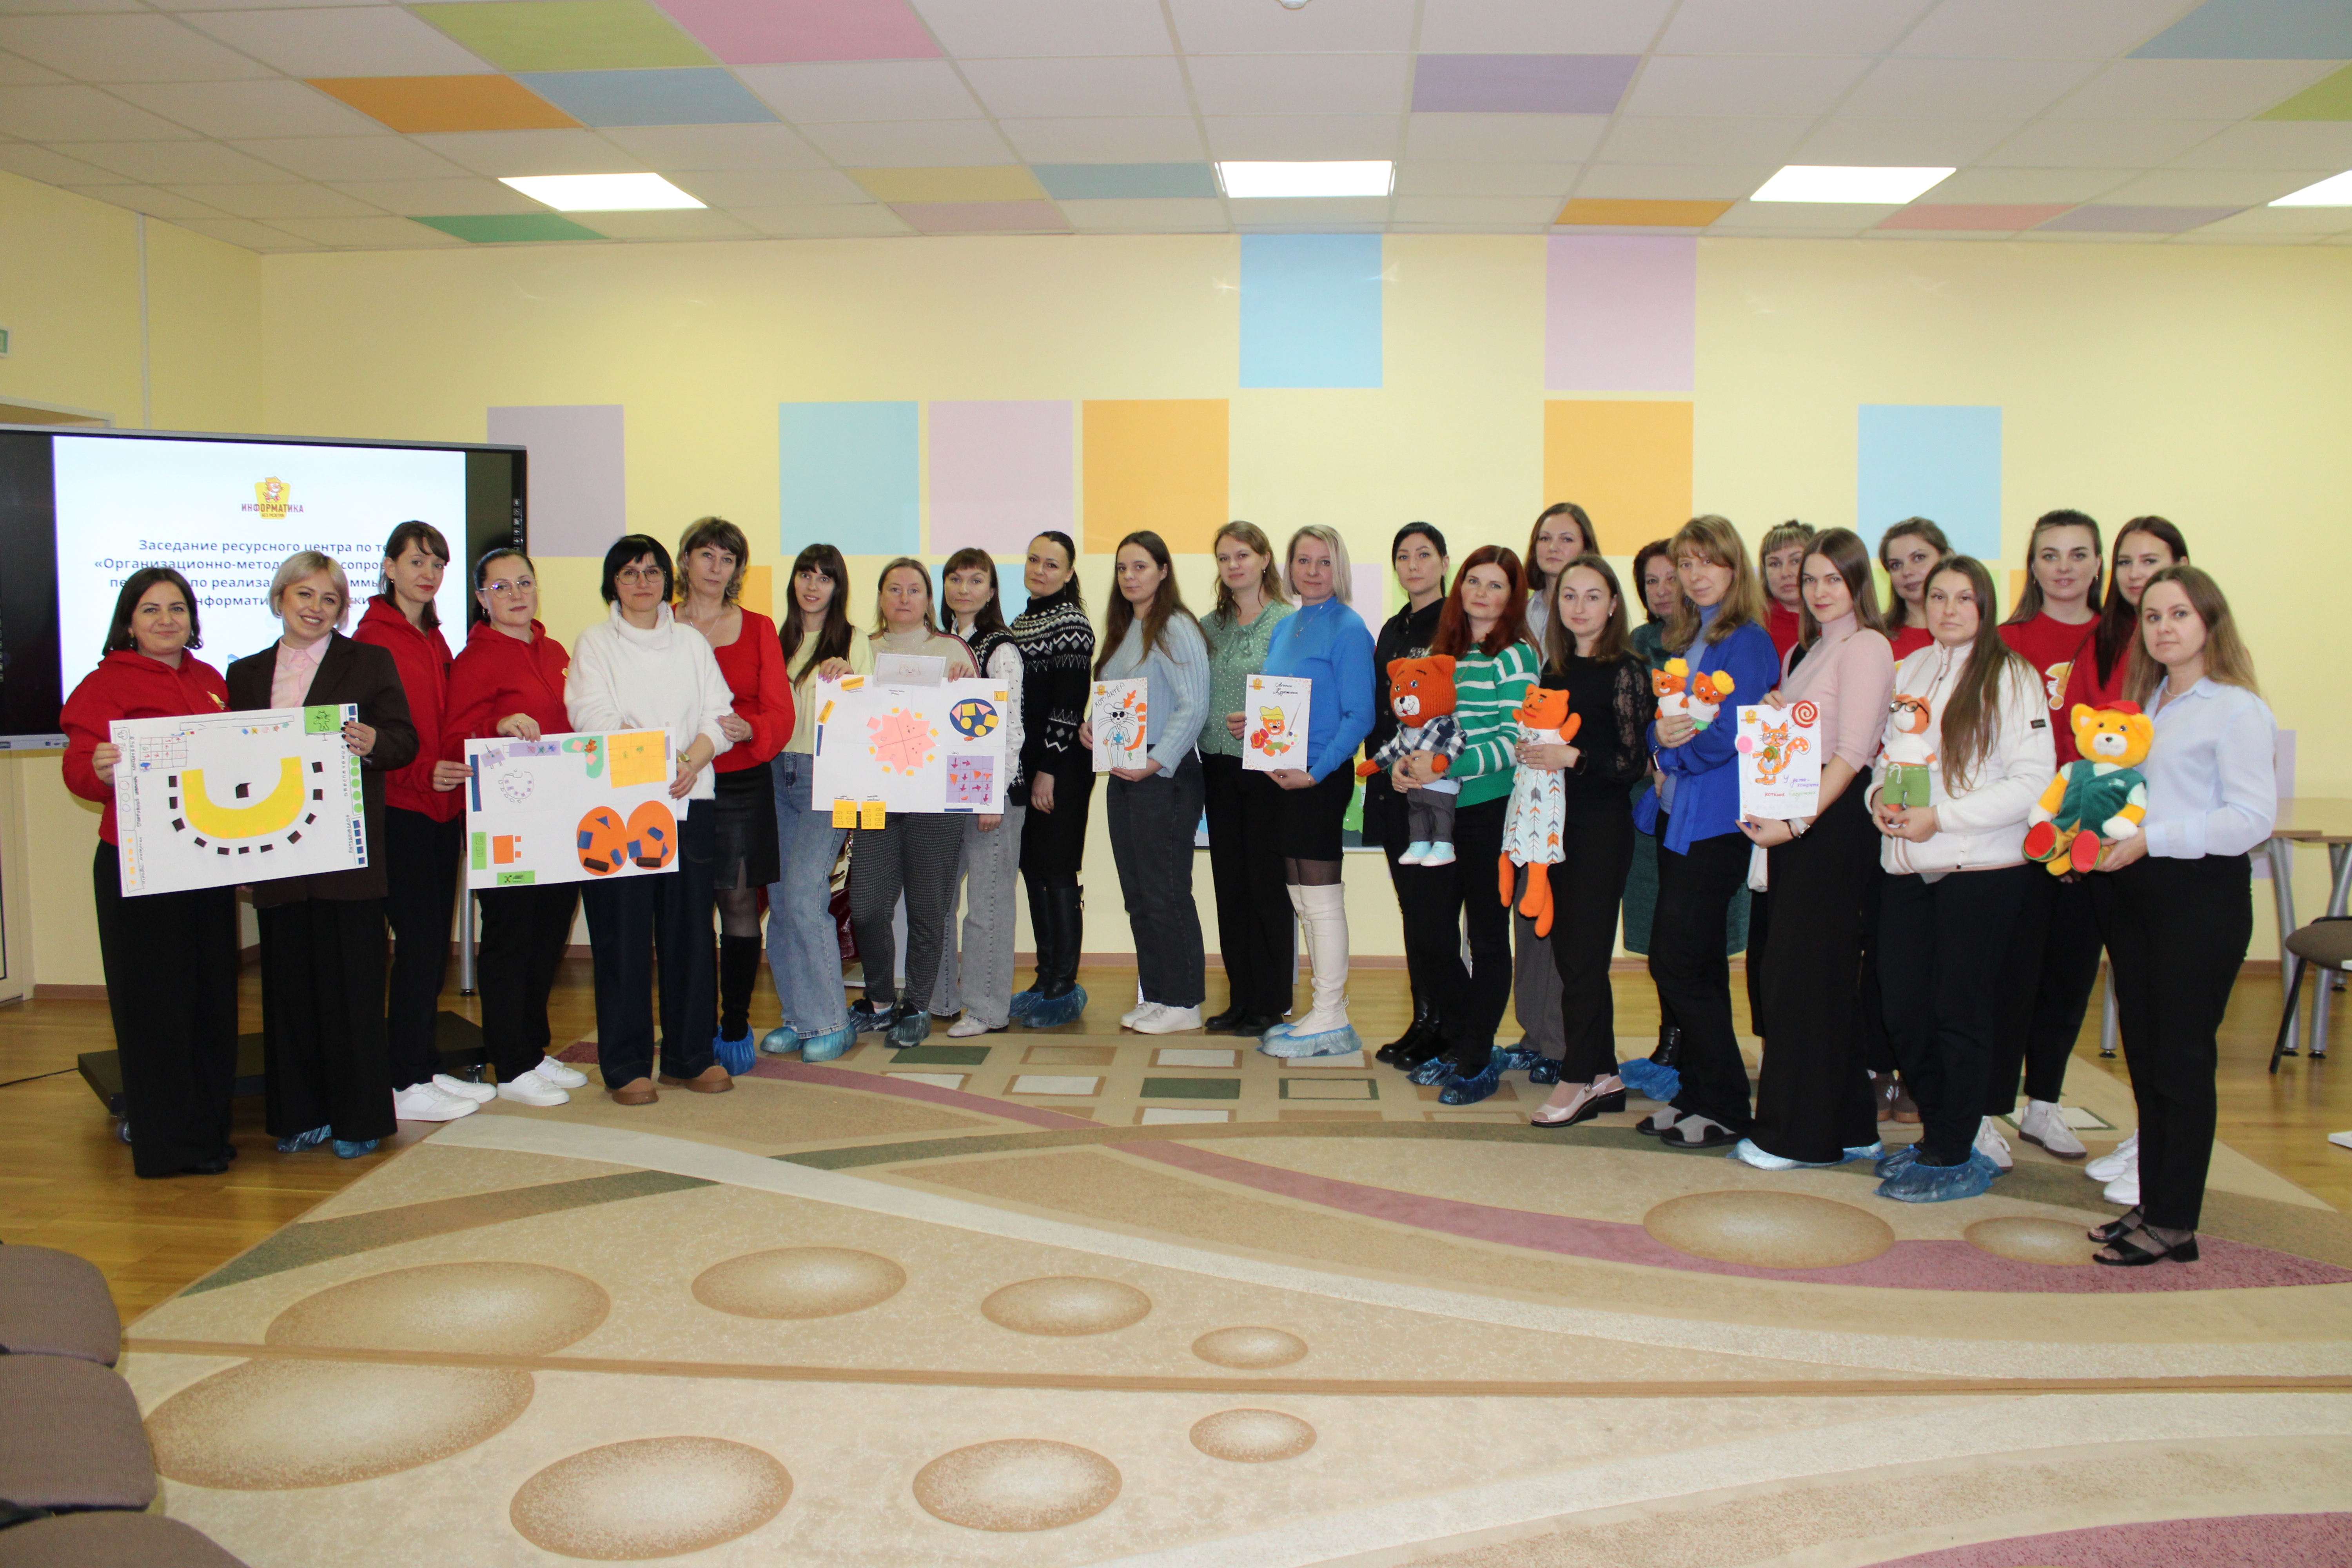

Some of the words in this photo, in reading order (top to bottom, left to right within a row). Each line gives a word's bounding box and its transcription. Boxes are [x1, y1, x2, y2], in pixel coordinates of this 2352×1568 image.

[241, 503, 304, 513] ИНФОРМАТИКА
[138, 540, 218, 552] Заседание
[222, 542, 300, 554] ресурсного
[304, 543, 352, 554] центра
[356, 544, 372, 552] по
[95, 558, 283, 572] «Организационно-метод
[191, 579, 207, 587] по
[212, 579, 270, 590] реализа
